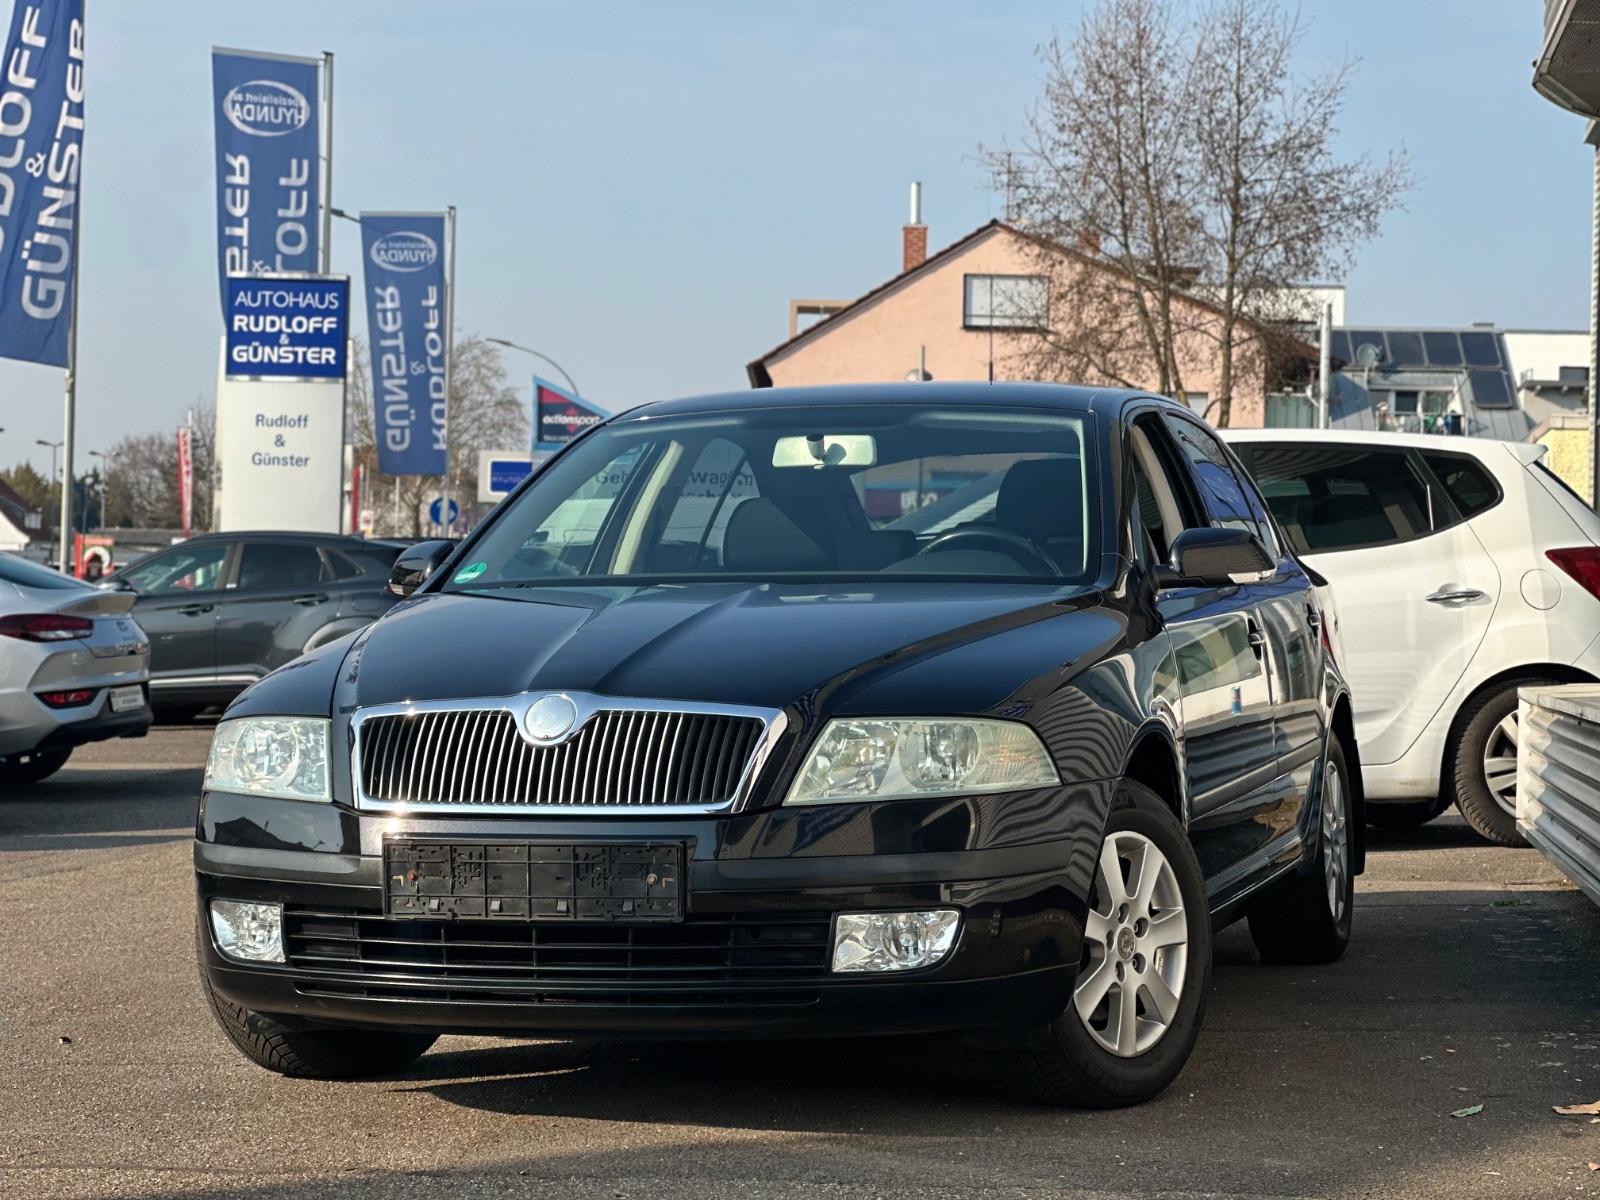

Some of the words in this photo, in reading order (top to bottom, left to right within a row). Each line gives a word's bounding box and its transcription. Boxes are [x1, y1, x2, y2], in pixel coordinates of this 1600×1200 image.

[21, 18, 84, 320] GÜNSTER
[25, 152, 46, 178] &
[234, 290, 339, 309] AUTOHAUS
[233, 315, 338, 334] RUDLOFF
[279, 333, 290, 345] &
[232, 341, 336, 365] GÜNSTER
[255, 413, 309, 428] Rudloff
[274, 434, 286, 448] &
[251, 452, 310, 467] Günster
